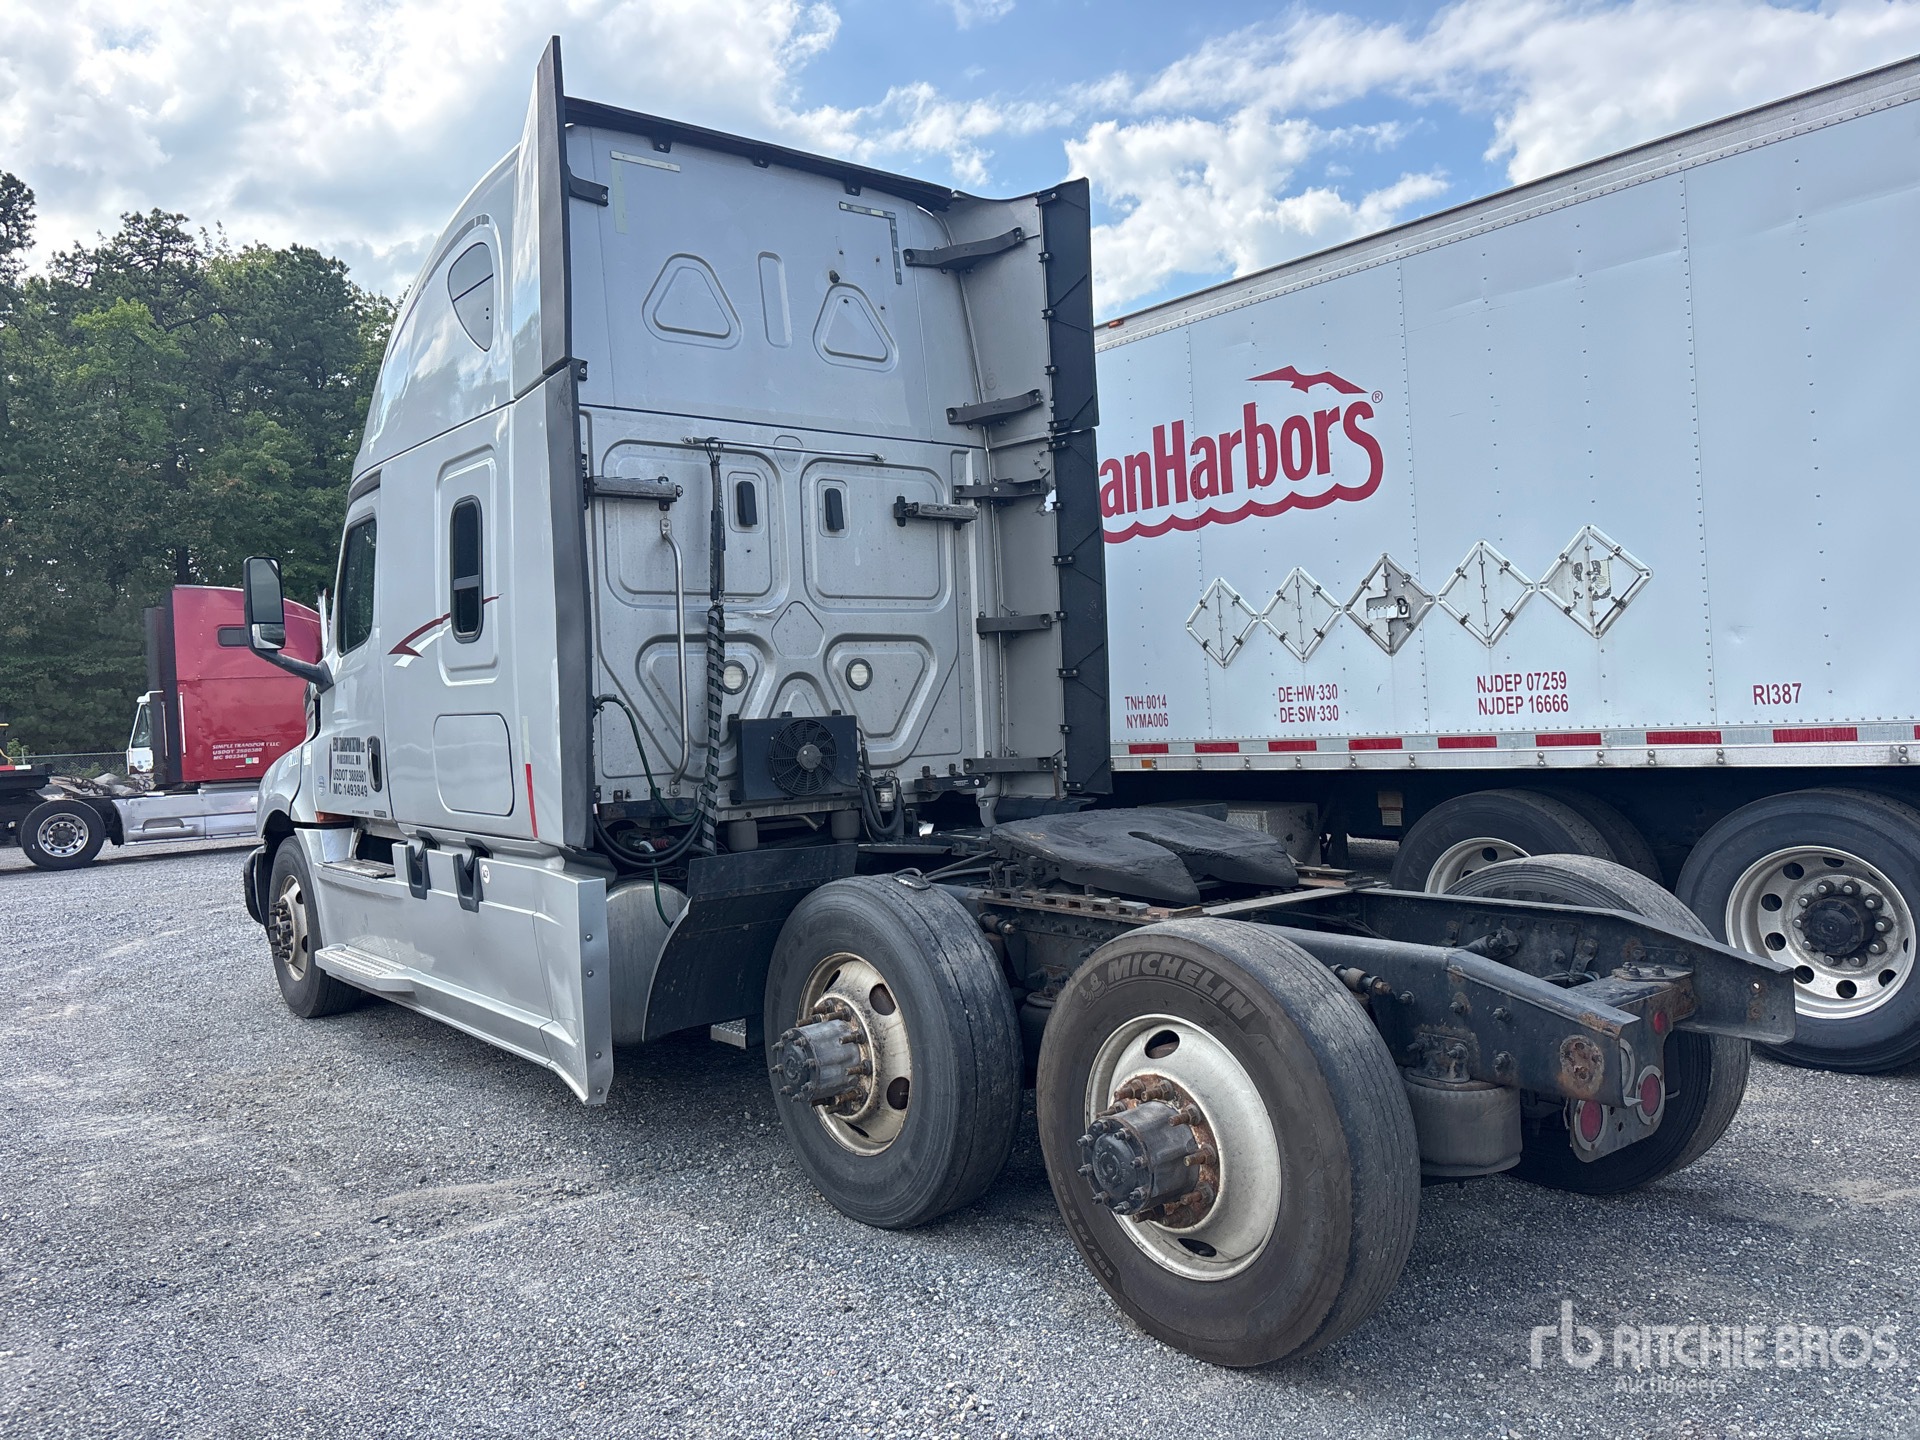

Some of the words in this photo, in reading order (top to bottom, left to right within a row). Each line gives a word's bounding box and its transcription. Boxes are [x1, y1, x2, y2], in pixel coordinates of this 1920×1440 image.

[1476, 674, 1522, 694] NJDEP
[1526, 671, 1567, 692] 07259
[1124, 694, 1167, 711] TNH-0014
[1752, 683, 1802, 705] RI387
[1478, 696, 1523, 716] NJDEP
[1528, 693, 1569, 714] 16666
[1126, 712, 1169, 729] NYMA006
[333, 768, 348, 781] USDOT
[333, 782, 342, 795] MC
[1107, 952, 1257, 1021] MICHELIN
